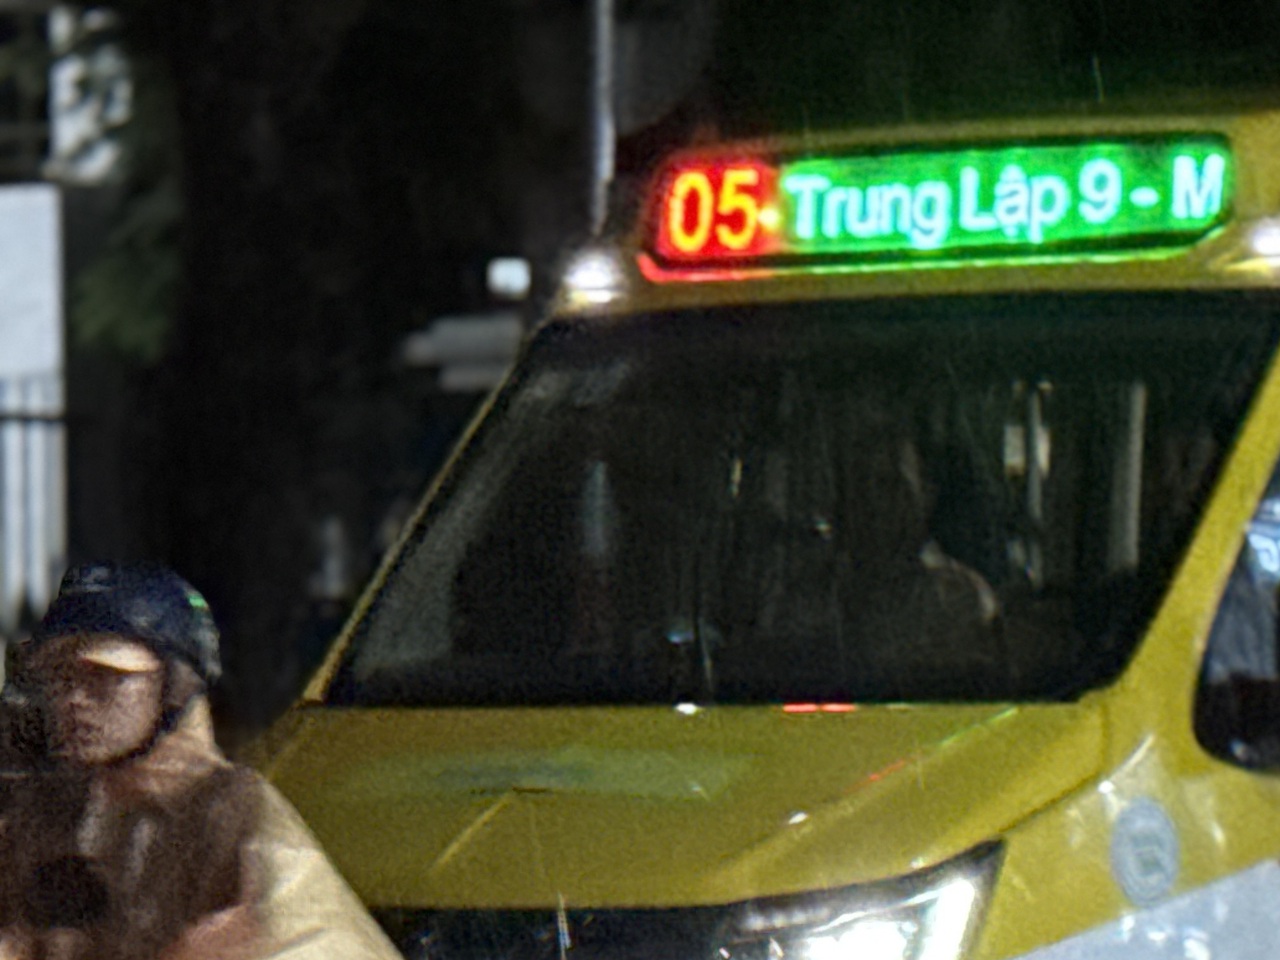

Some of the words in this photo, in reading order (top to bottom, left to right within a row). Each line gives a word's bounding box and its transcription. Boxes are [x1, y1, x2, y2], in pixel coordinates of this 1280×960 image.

[784, 172, 950, 249] Trung
[960, 164, 1068, 242] Lập
[1079, 159, 1122, 223] 9
[1171, 153, 1224, 219] M
